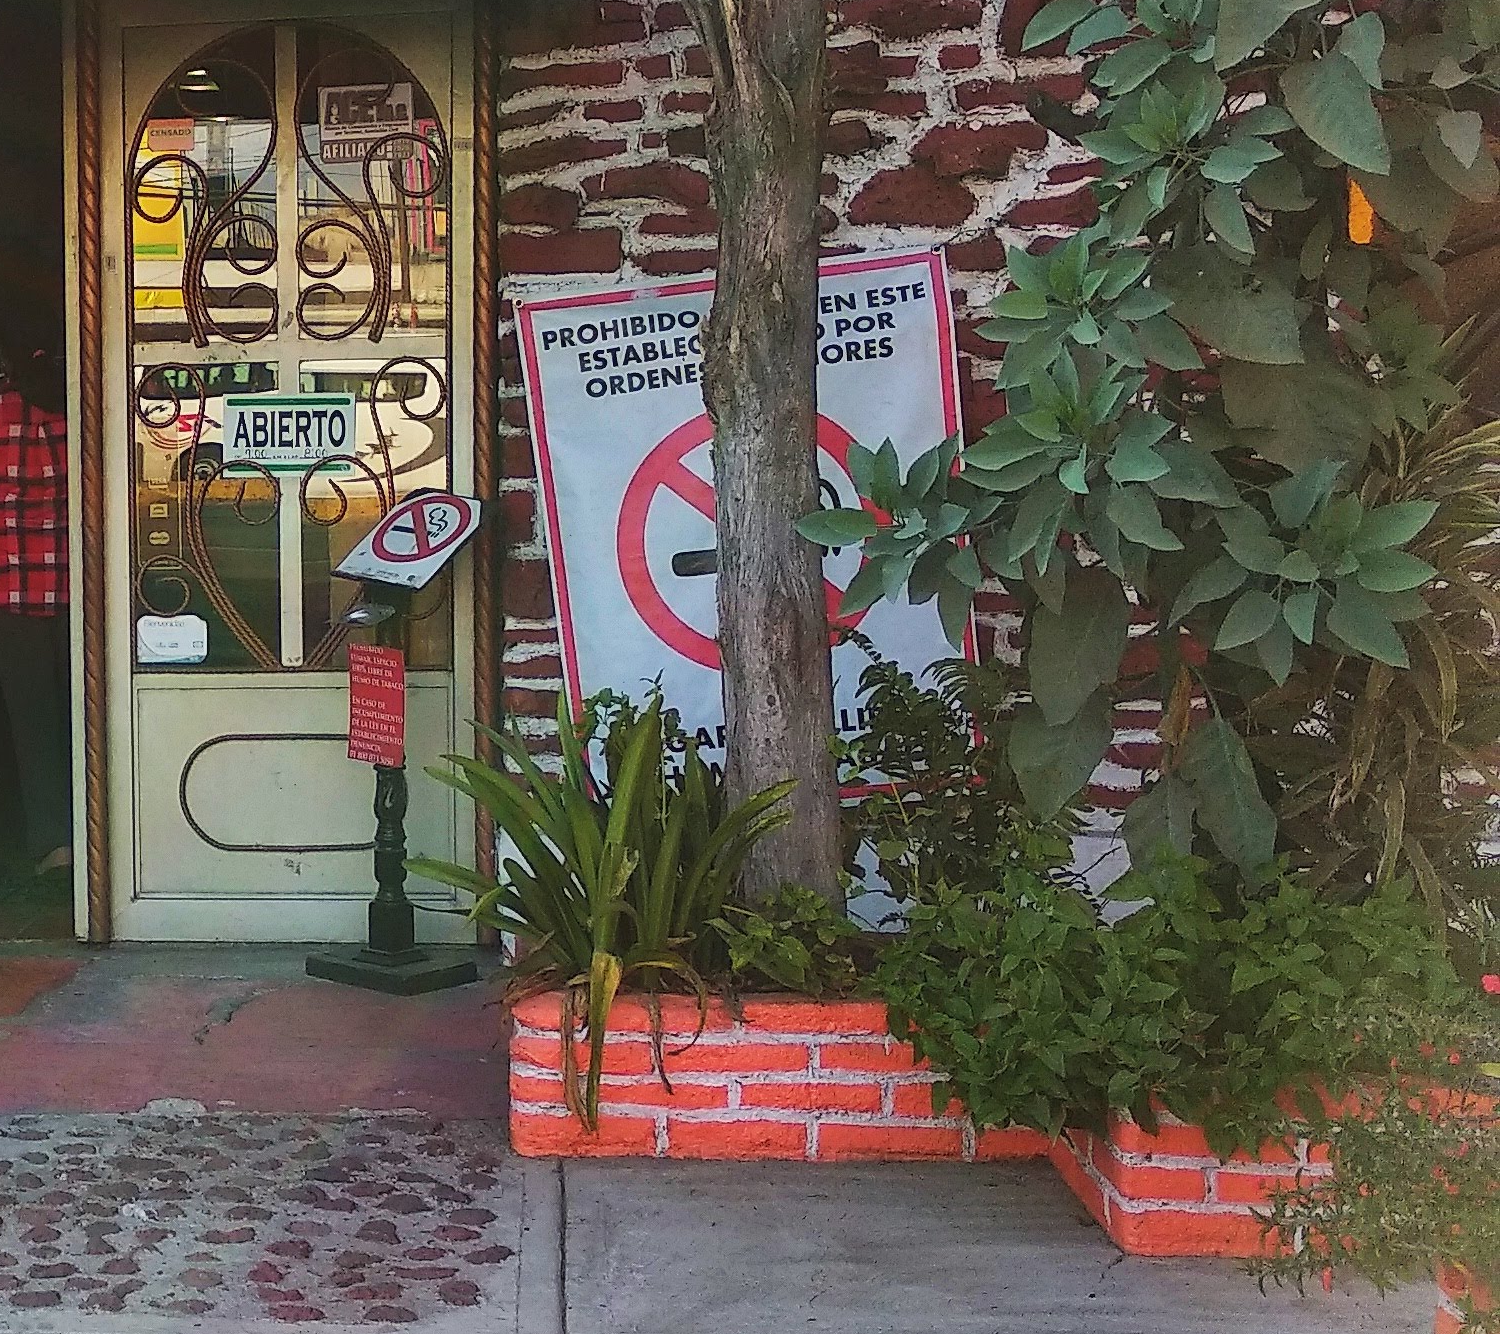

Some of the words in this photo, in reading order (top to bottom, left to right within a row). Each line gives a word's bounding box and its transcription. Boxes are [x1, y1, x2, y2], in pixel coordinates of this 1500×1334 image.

[542, 310, 700, 351] PROHIBIDO
[820, 292, 857, 315] EN
[866, 281, 926, 308] ESTE
[835, 312, 896, 338] POR
[586, 362, 704, 398] ORDENE
[232, 409, 346, 448] ABIERTO
